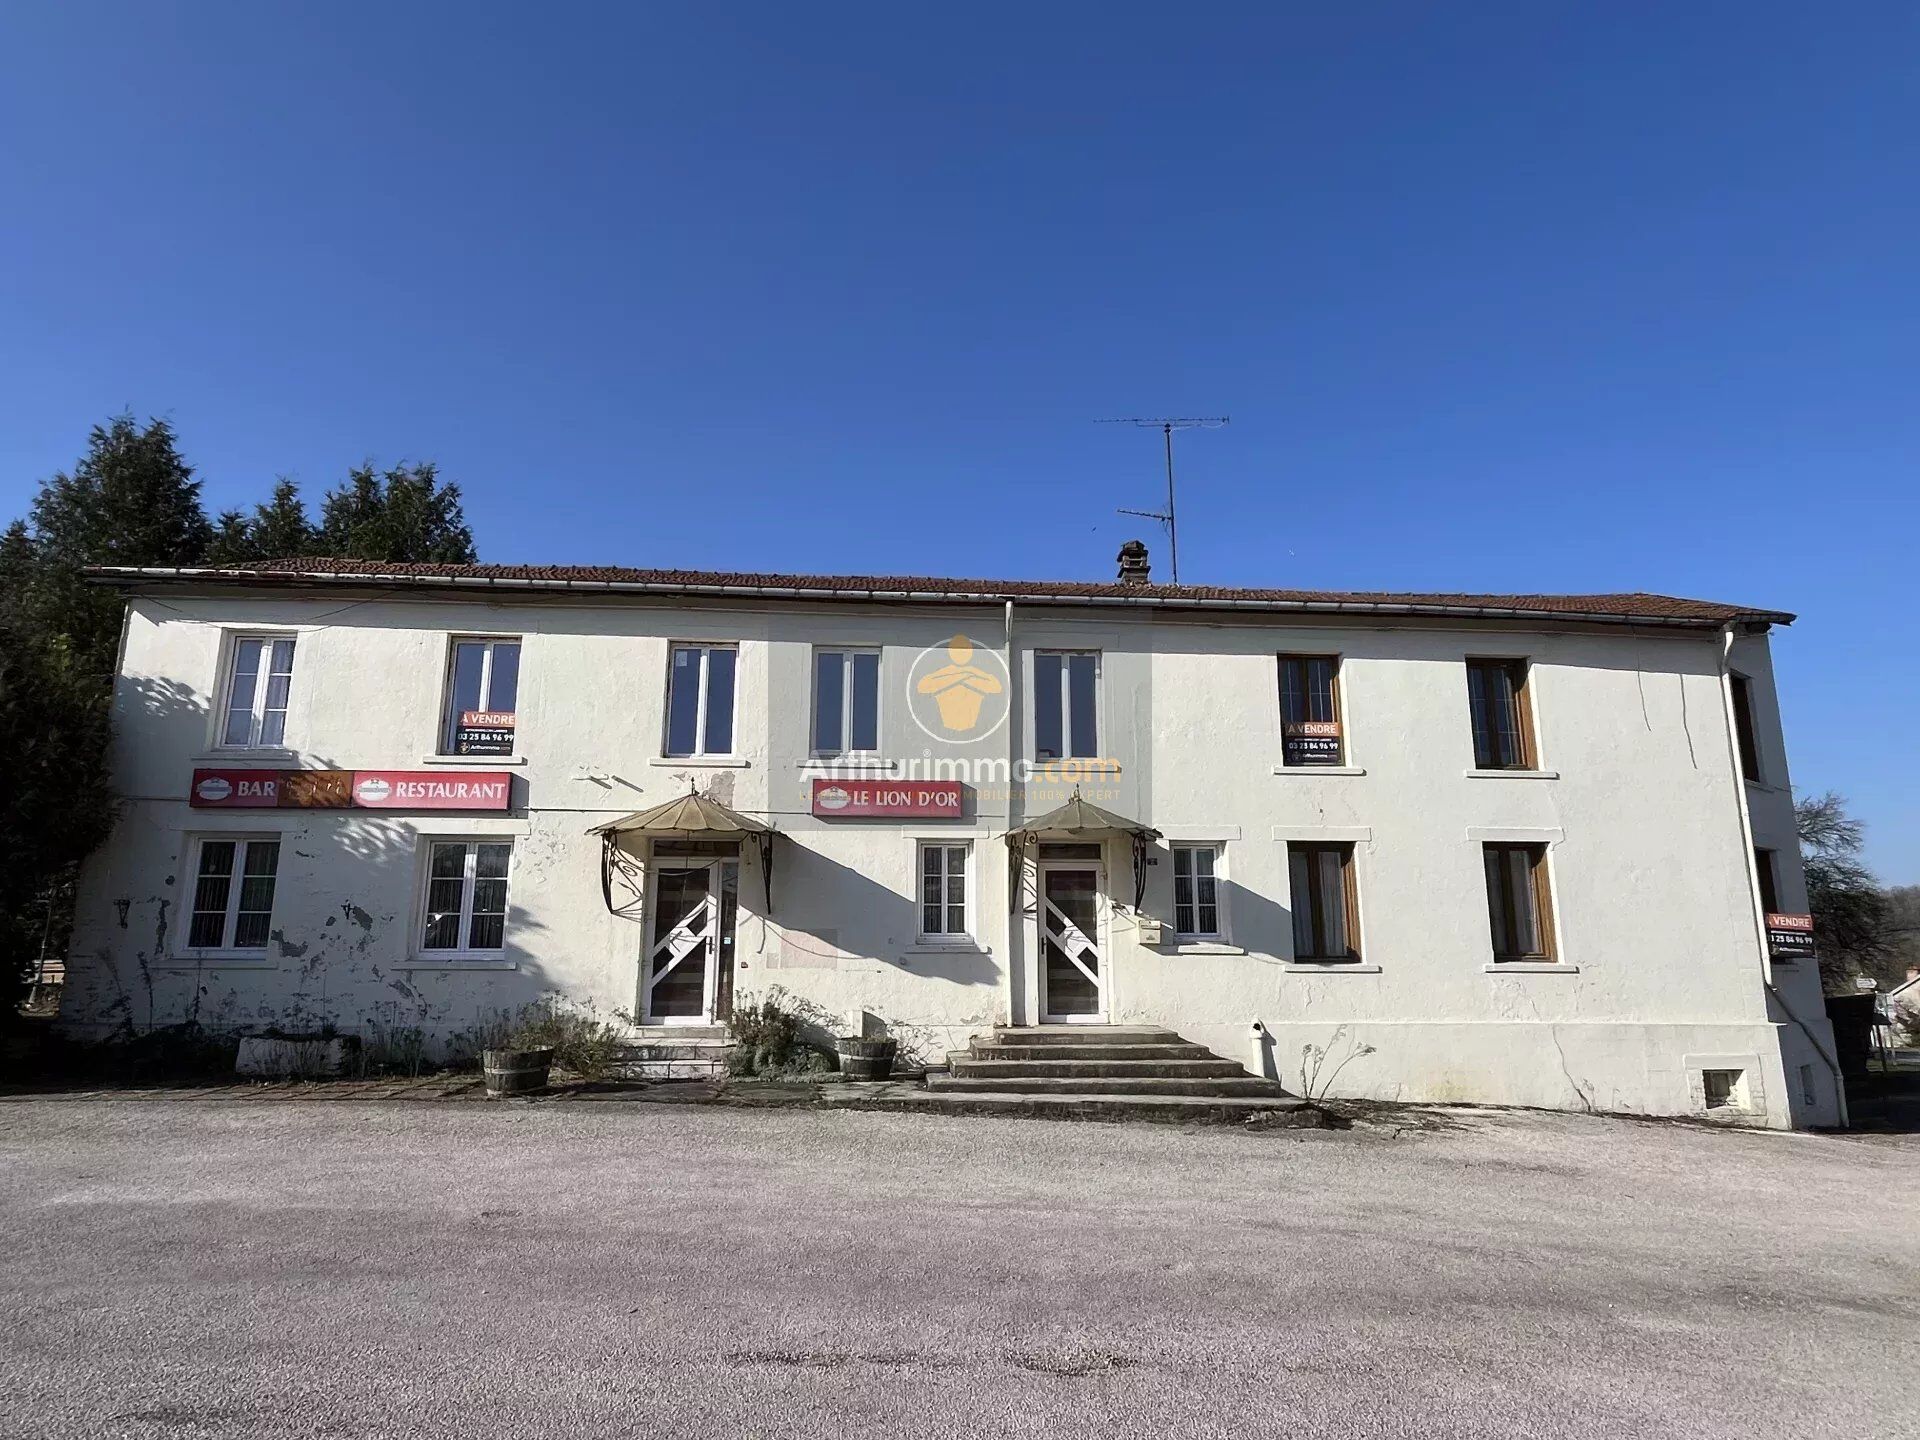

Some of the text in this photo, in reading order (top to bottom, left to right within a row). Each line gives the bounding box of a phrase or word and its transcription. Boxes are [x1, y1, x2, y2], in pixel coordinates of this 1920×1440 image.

[472, 714, 515, 725] VENDRE
[1288, 724, 1337, 734] A VENDRE
[458, 733, 514, 742] 03 25 84 96 99
[1300, 742, 1308, 750] 25
[1309, 742, 1319, 750] 84
[1319, 742, 1329, 750] 96
[1329, 742, 1339, 750] 99
[238, 781, 276, 797] BAR
[396, 781, 506, 799] RESTAURANT
[853, 790, 958, 807] LE LION D'OR
[1773, 916, 1810, 928] VENDRE
[1775, 935, 1785, 943] 25
